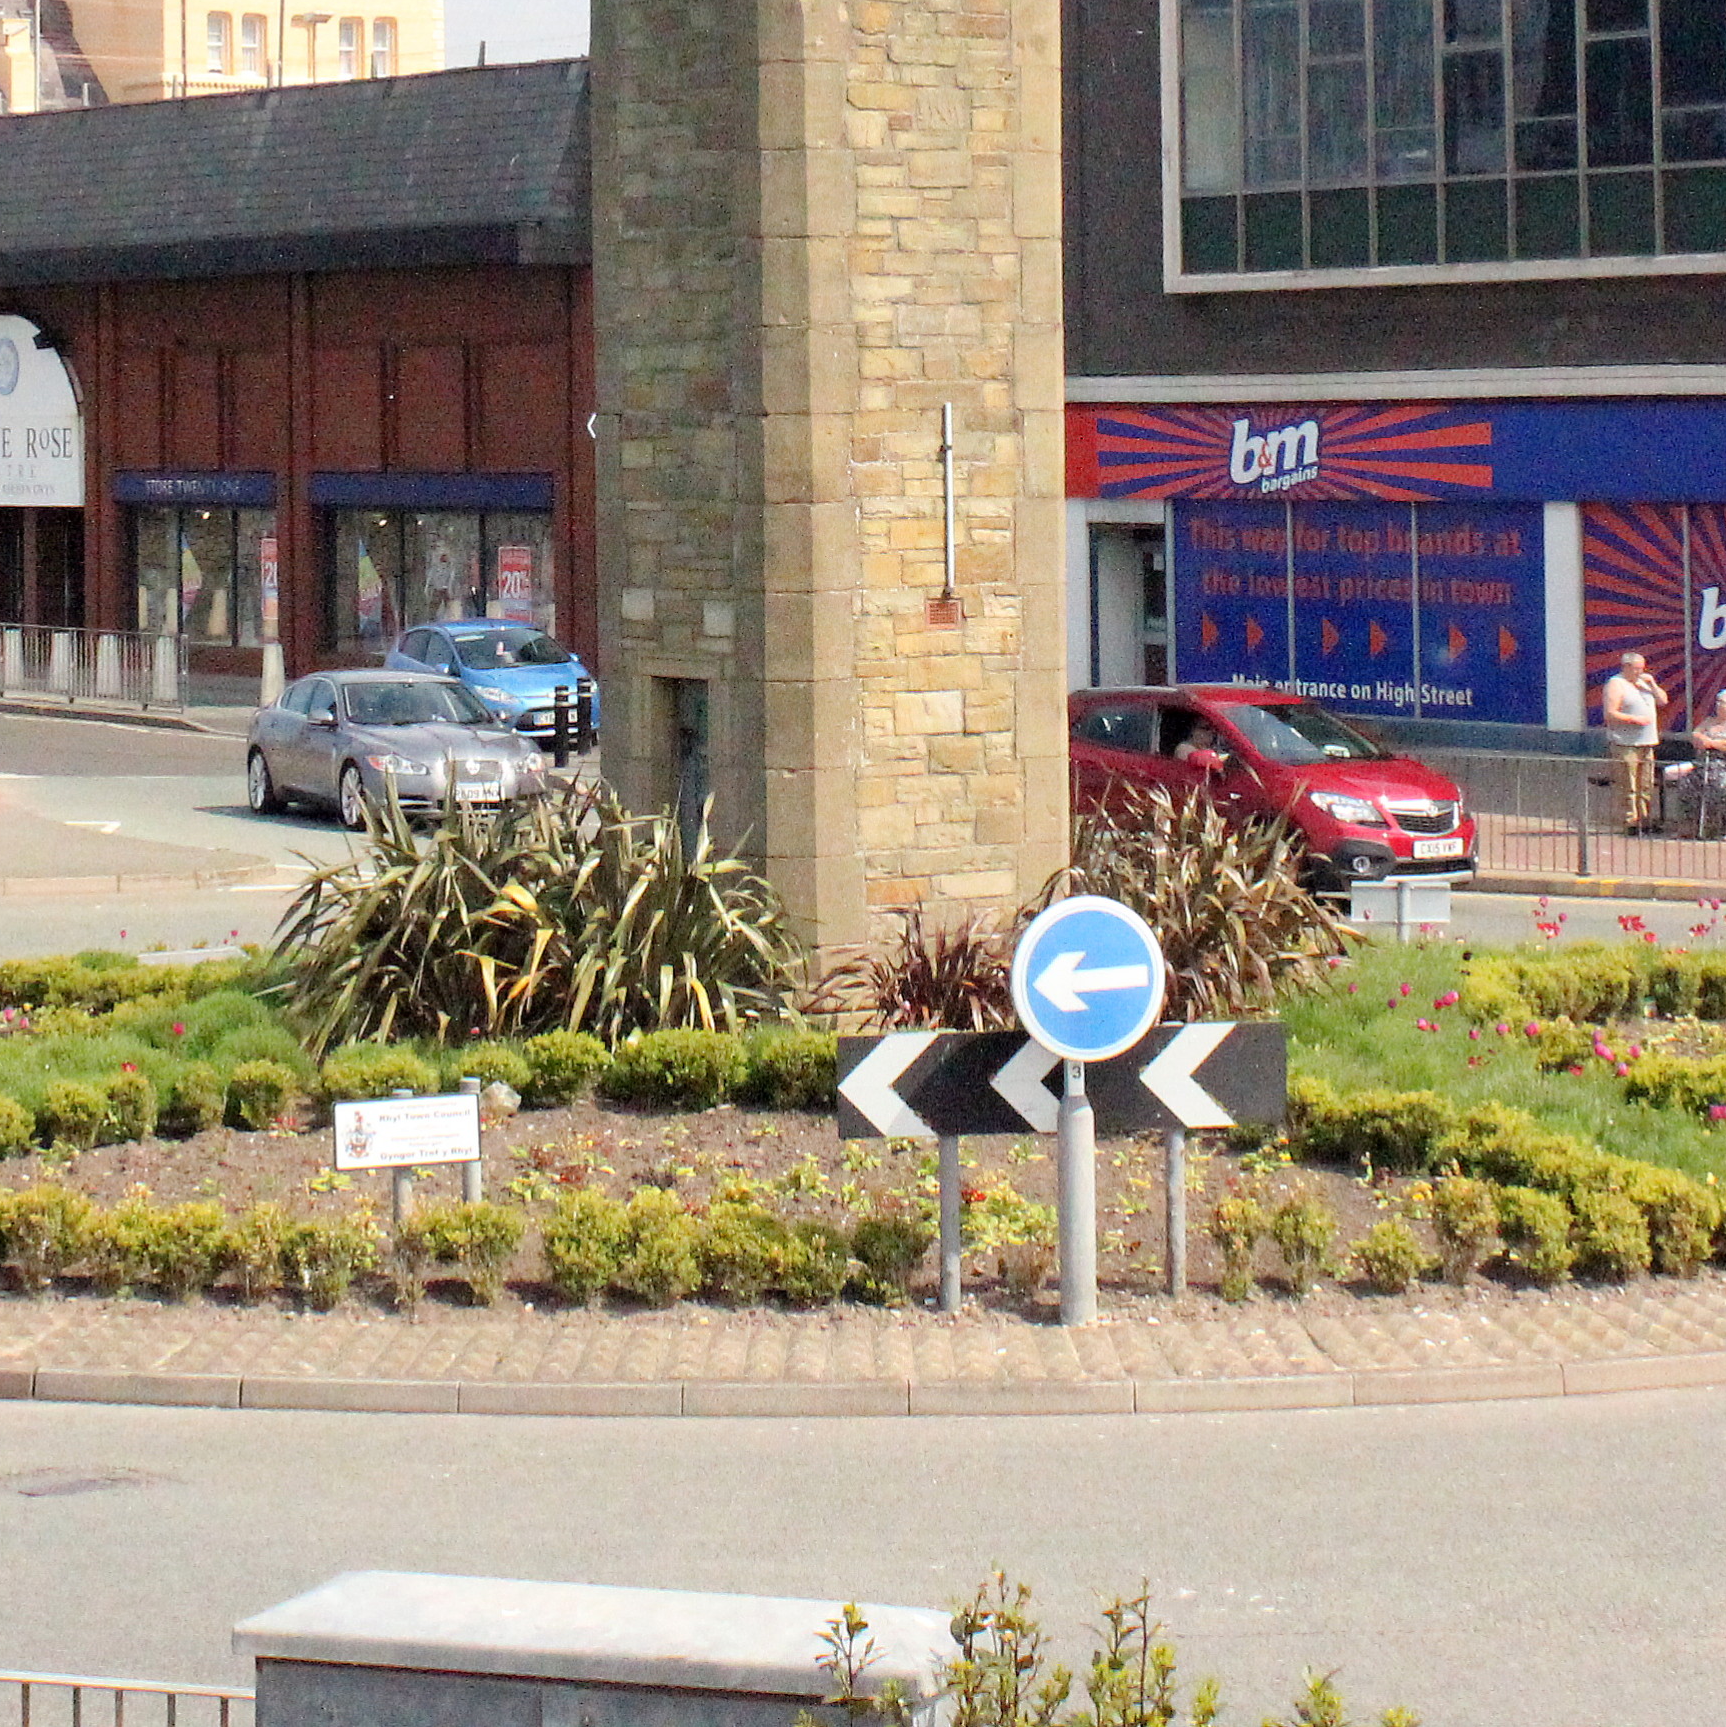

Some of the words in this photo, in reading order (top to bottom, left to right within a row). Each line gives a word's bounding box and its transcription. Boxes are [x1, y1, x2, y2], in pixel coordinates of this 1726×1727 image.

[26, 428, 73, 458] ROSE
[1261, 466, 1318, 494] bargains
[1188, 517, 1235, 552] This
[1295, 519, 1331, 553] for
[1336, 524, 1380, 561] top
[1495, 528, 1523, 557] at
[1202, 565, 1240, 596] the
[1351, 684, 1371, 699] on
[1376, 681, 1415, 707] High
[1421, 684, 1473, 706] Street
[1072, 1066, 1082, 1079] 3
[379, 1114, 401, 1123] Rhyl
[405, 1112, 430, 1120] Town
[434, 1109, 471, 1118] Council
[451, 1147, 472, 1156] Rhyl
